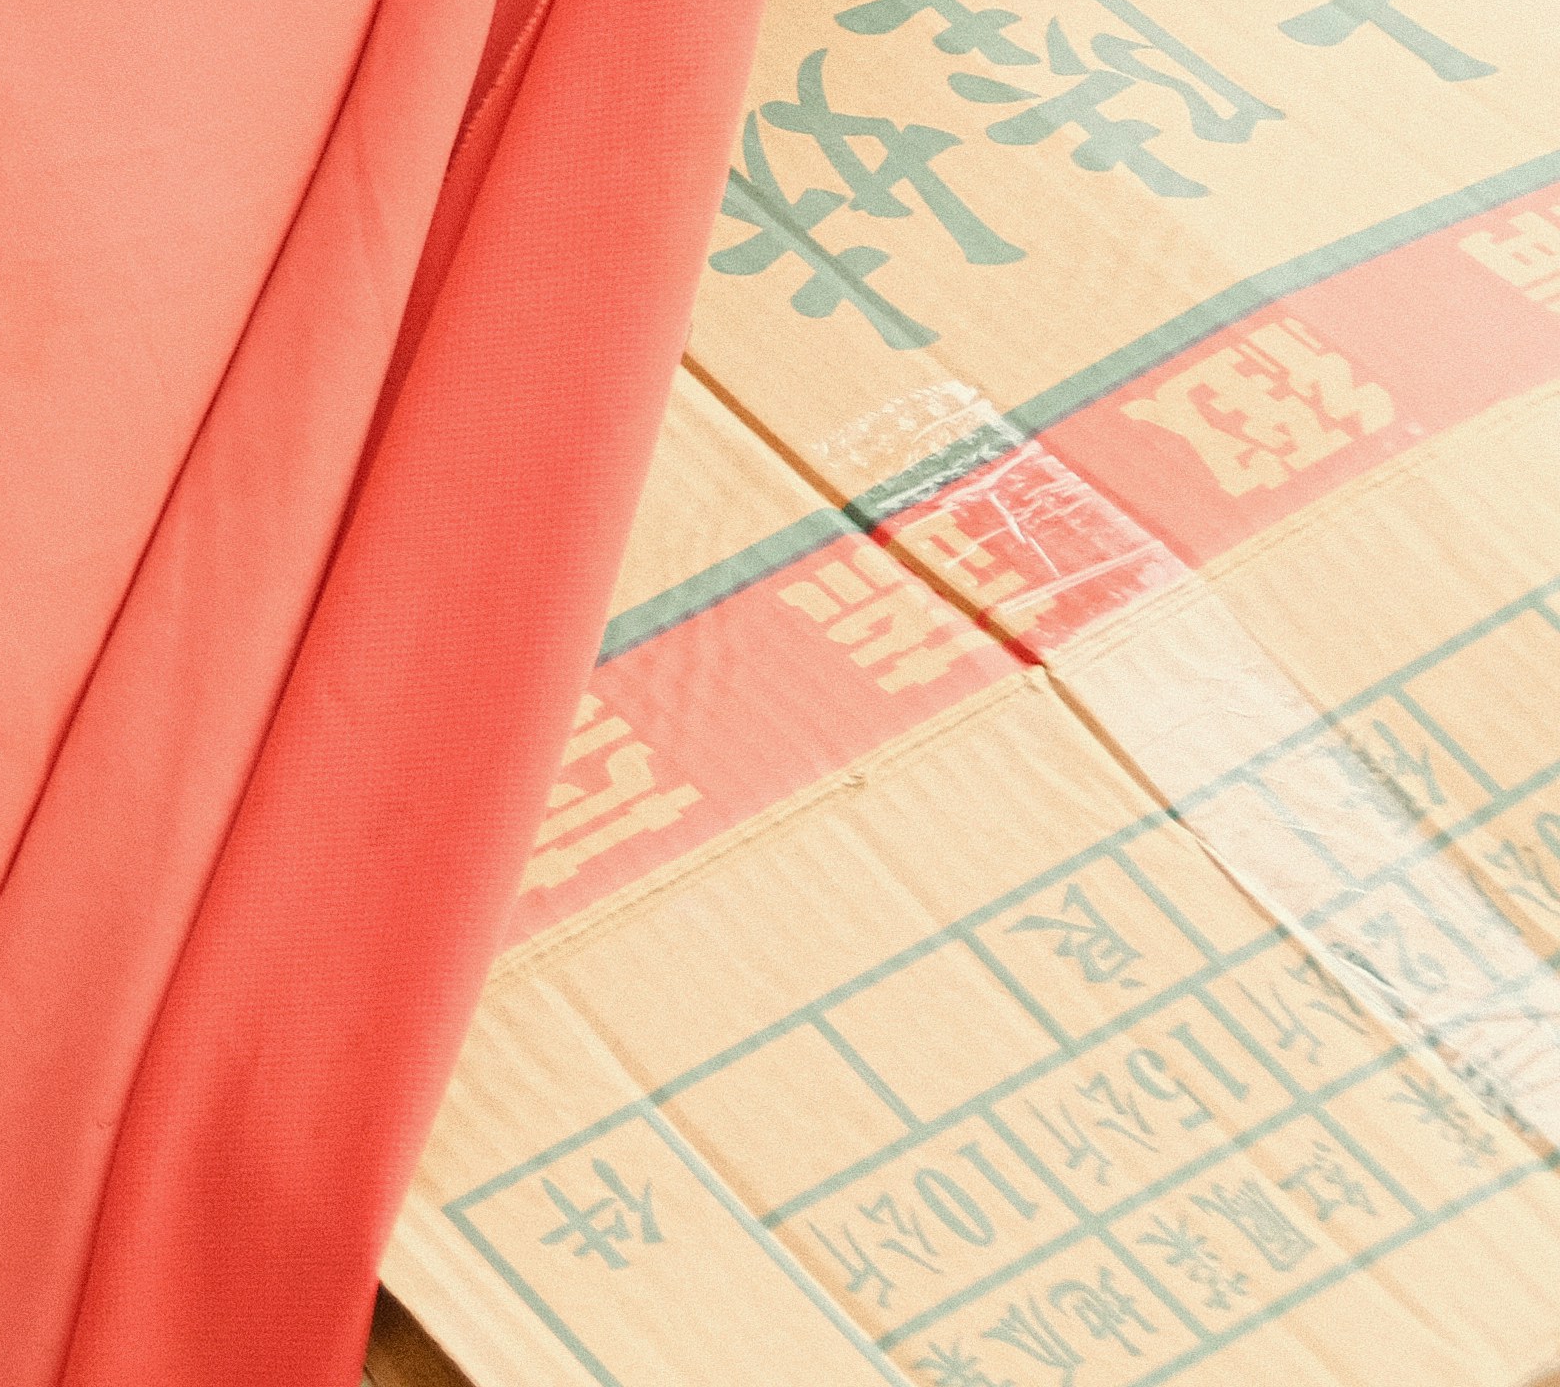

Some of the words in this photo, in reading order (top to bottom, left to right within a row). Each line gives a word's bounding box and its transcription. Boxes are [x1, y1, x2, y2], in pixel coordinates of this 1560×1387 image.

[1003, 882, 1146, 990] 良
[1022, 1022, 1251, 1188] 15公斤
[539, 1156, 664, 1270] 件
[807, 1140, 1040, 1309] 10公斤
[1137, 1141, 1379, 1312] 紅鳳菜
